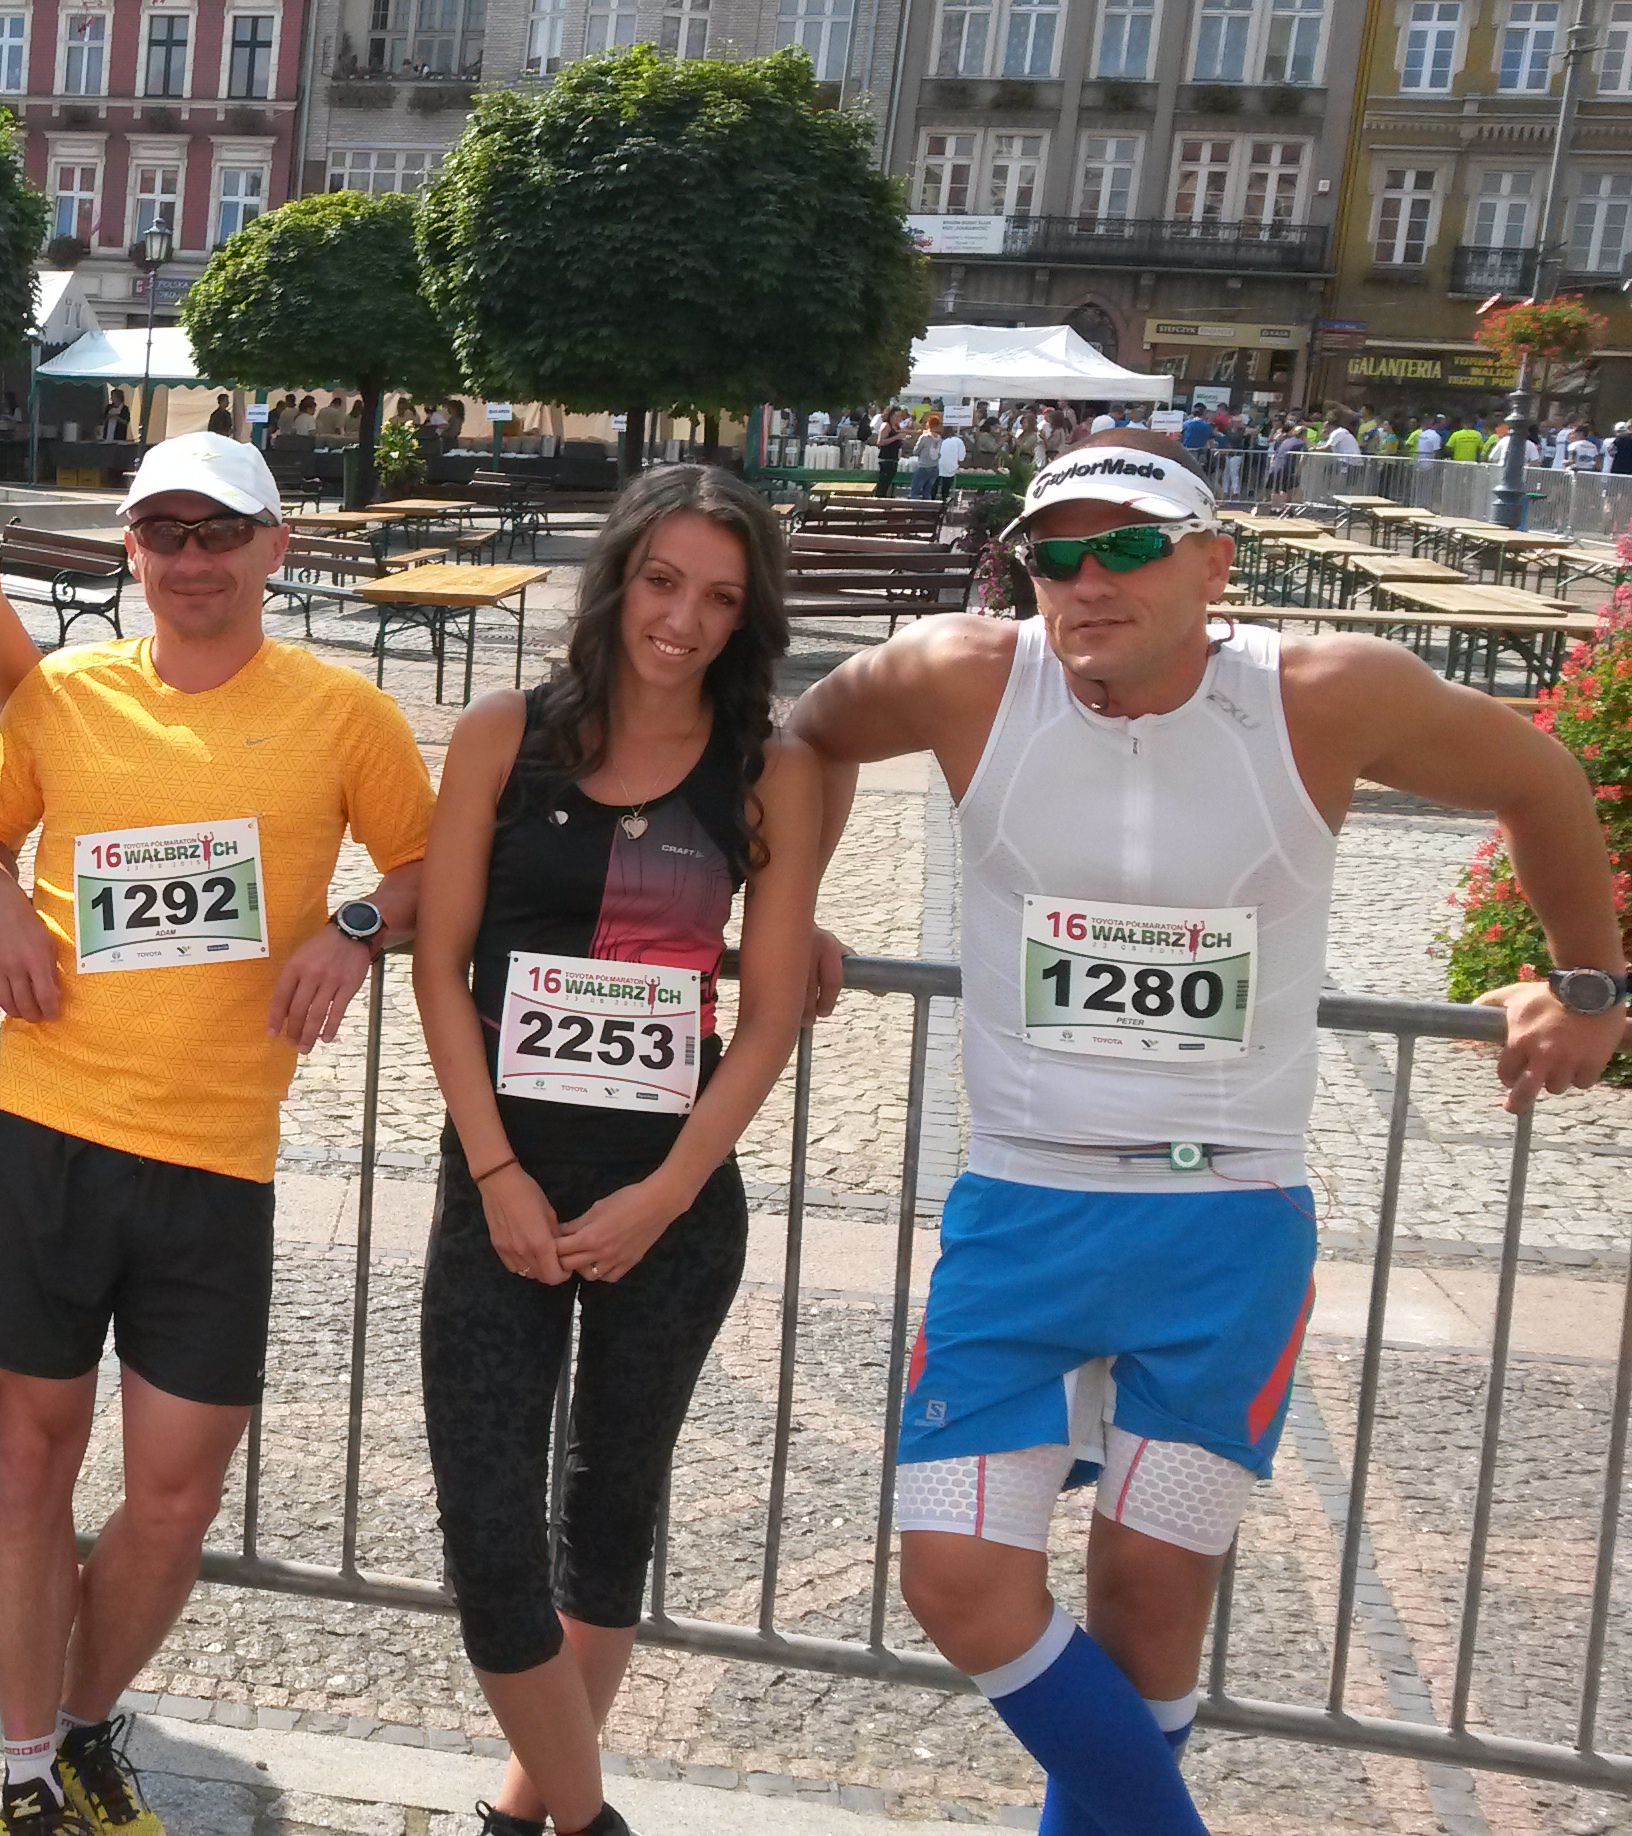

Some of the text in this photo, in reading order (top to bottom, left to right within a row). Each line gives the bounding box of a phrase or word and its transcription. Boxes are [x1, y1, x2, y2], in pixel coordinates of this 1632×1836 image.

[1348, 356, 1442, 379] GALANTERIA
[1032, 458, 1166, 498] TaylorMade
[91, 843, 122, 870] 16
[661, 844, 696, 856] CRAFT
[91, 876, 239, 931] 1292
[154, 929, 177, 937] ADAM
[1046, 911, 1087, 941] 16
[1091, 917, 1125, 926] TOYOTA
[528, 966, 562, 993] 16
[1041, 958, 1224, 1019] 1280
[1116, 1016, 1145, 1026] PETER
[515, 1010, 675, 1070] 2253
